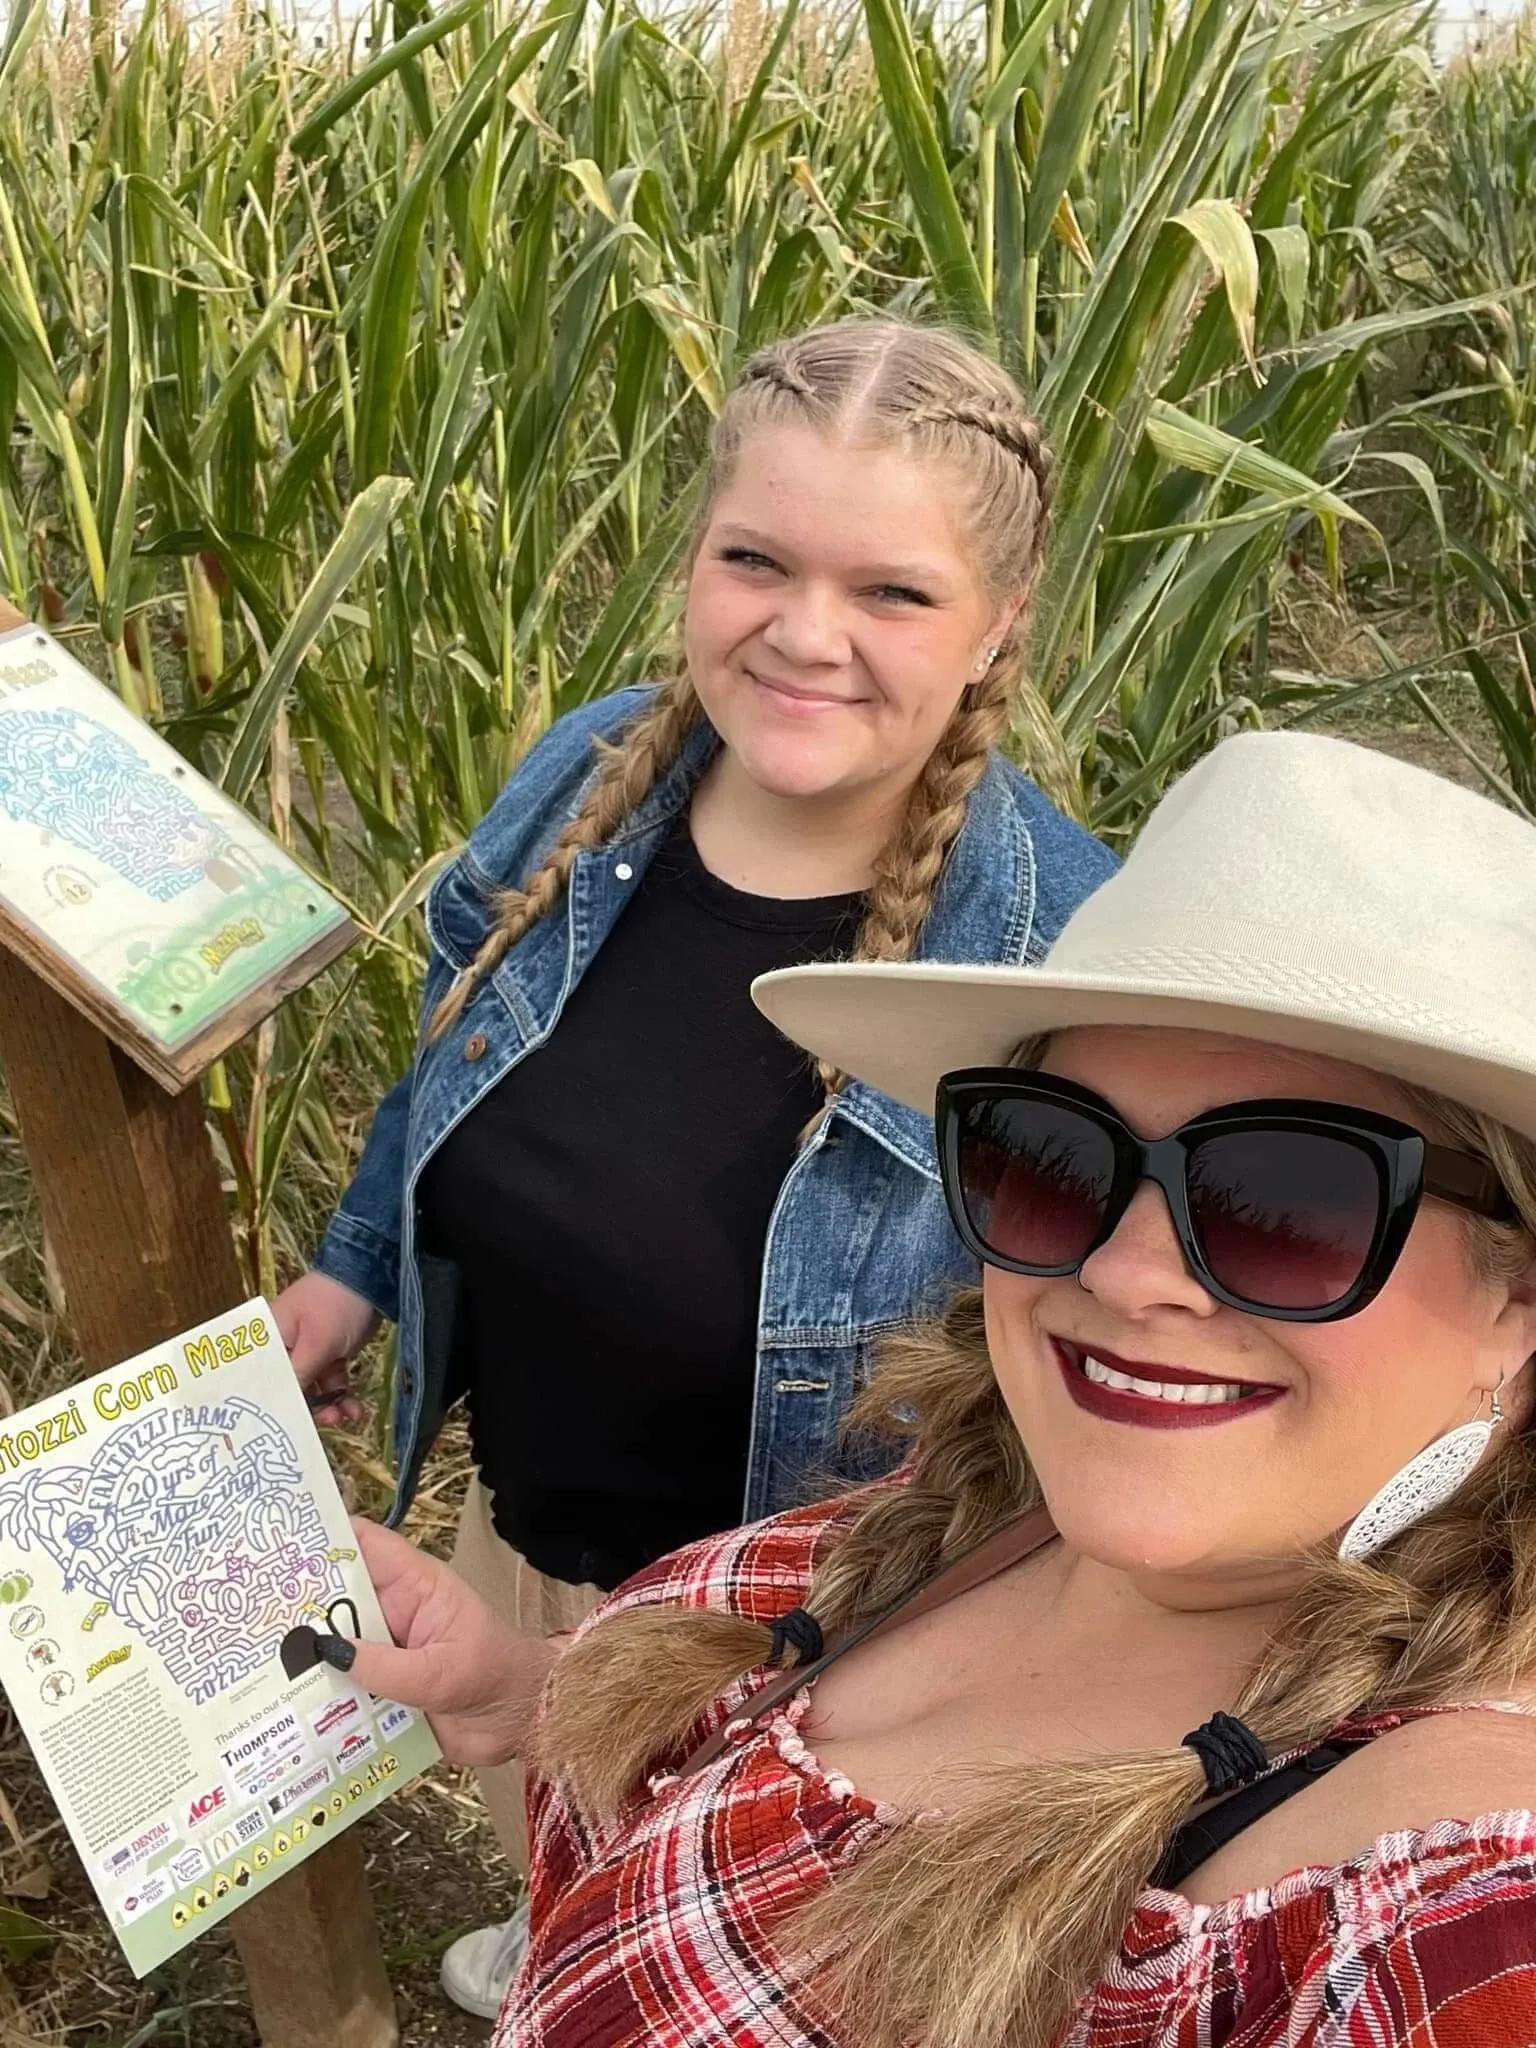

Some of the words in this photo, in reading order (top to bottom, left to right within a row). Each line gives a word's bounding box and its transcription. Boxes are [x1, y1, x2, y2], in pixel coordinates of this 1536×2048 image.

[0, 1400, 88, 1475] tozzi
[93, 1363, 179, 1421] Corn
[184, 1317, 270, 1378] Maze
[172, 1405, 240, 1434] FARMS
[127, 1472, 157, 1502] 20
[162, 1463, 195, 1499] yrs
[200, 1444, 218, 1476] of
[214, 1719, 250, 1746] Thanks
[251, 1709, 262, 1723] to
[263, 1699, 280, 1715] our
[221, 1714, 295, 1767] THOMPSON
[188, 1785, 227, 1825] ACE
[282, 1766, 330, 1807] Pharmacy
[131, 1821, 171, 1853] DENTAL
[219, 1880, 229, 1894] 3
[257, 1851, 269, 1866] 5
[279, 1839, 288, 1852] 6
[296, 1825, 305, 1839] 7
[333, 1797, 342, 1811] 9
[349, 1784, 363, 1800] 10
[383, 1758, 398, 1772] 12
[236, 1810, 259, 1830] GOLDEN
[239, 1819, 264, 1839] STATE
